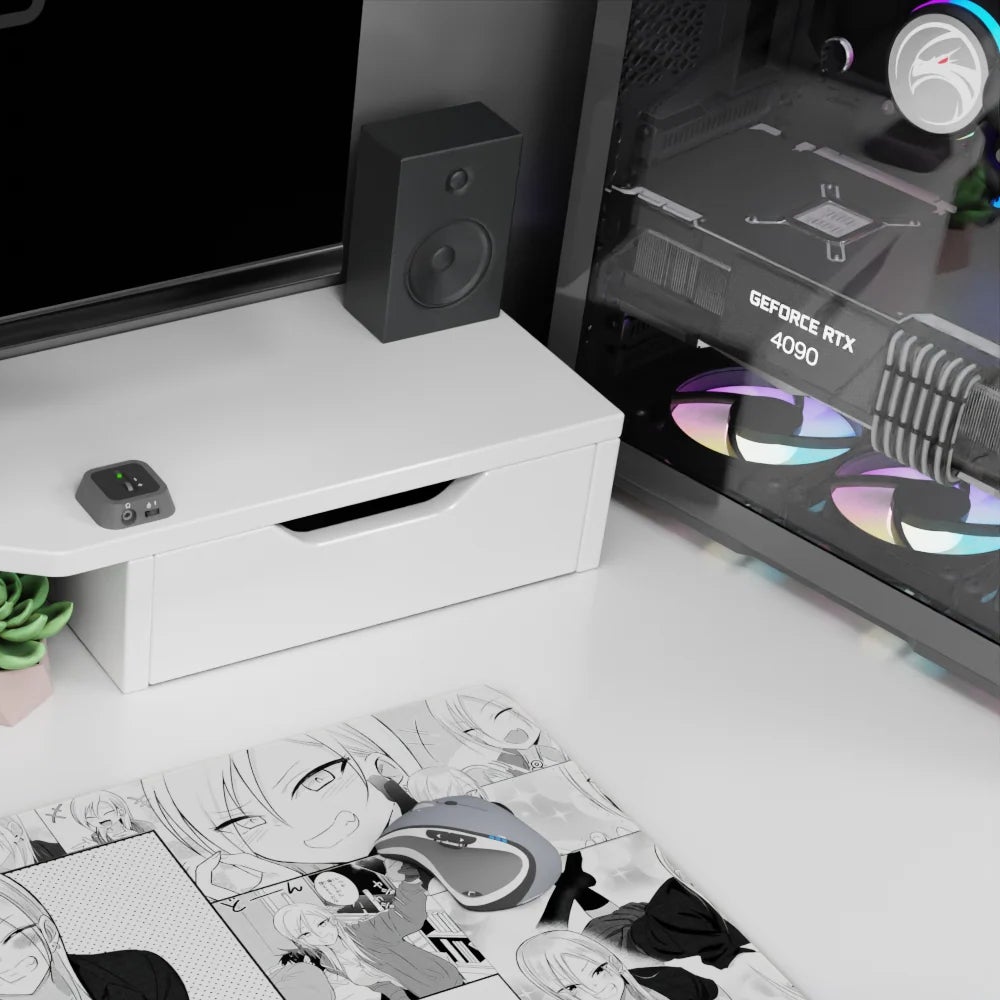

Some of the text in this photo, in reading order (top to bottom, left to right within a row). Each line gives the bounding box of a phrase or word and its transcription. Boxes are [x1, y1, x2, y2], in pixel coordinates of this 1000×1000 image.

[749, 289, 856, 354] GEFORCE RTX
[770, 331, 819, 367] 4090
